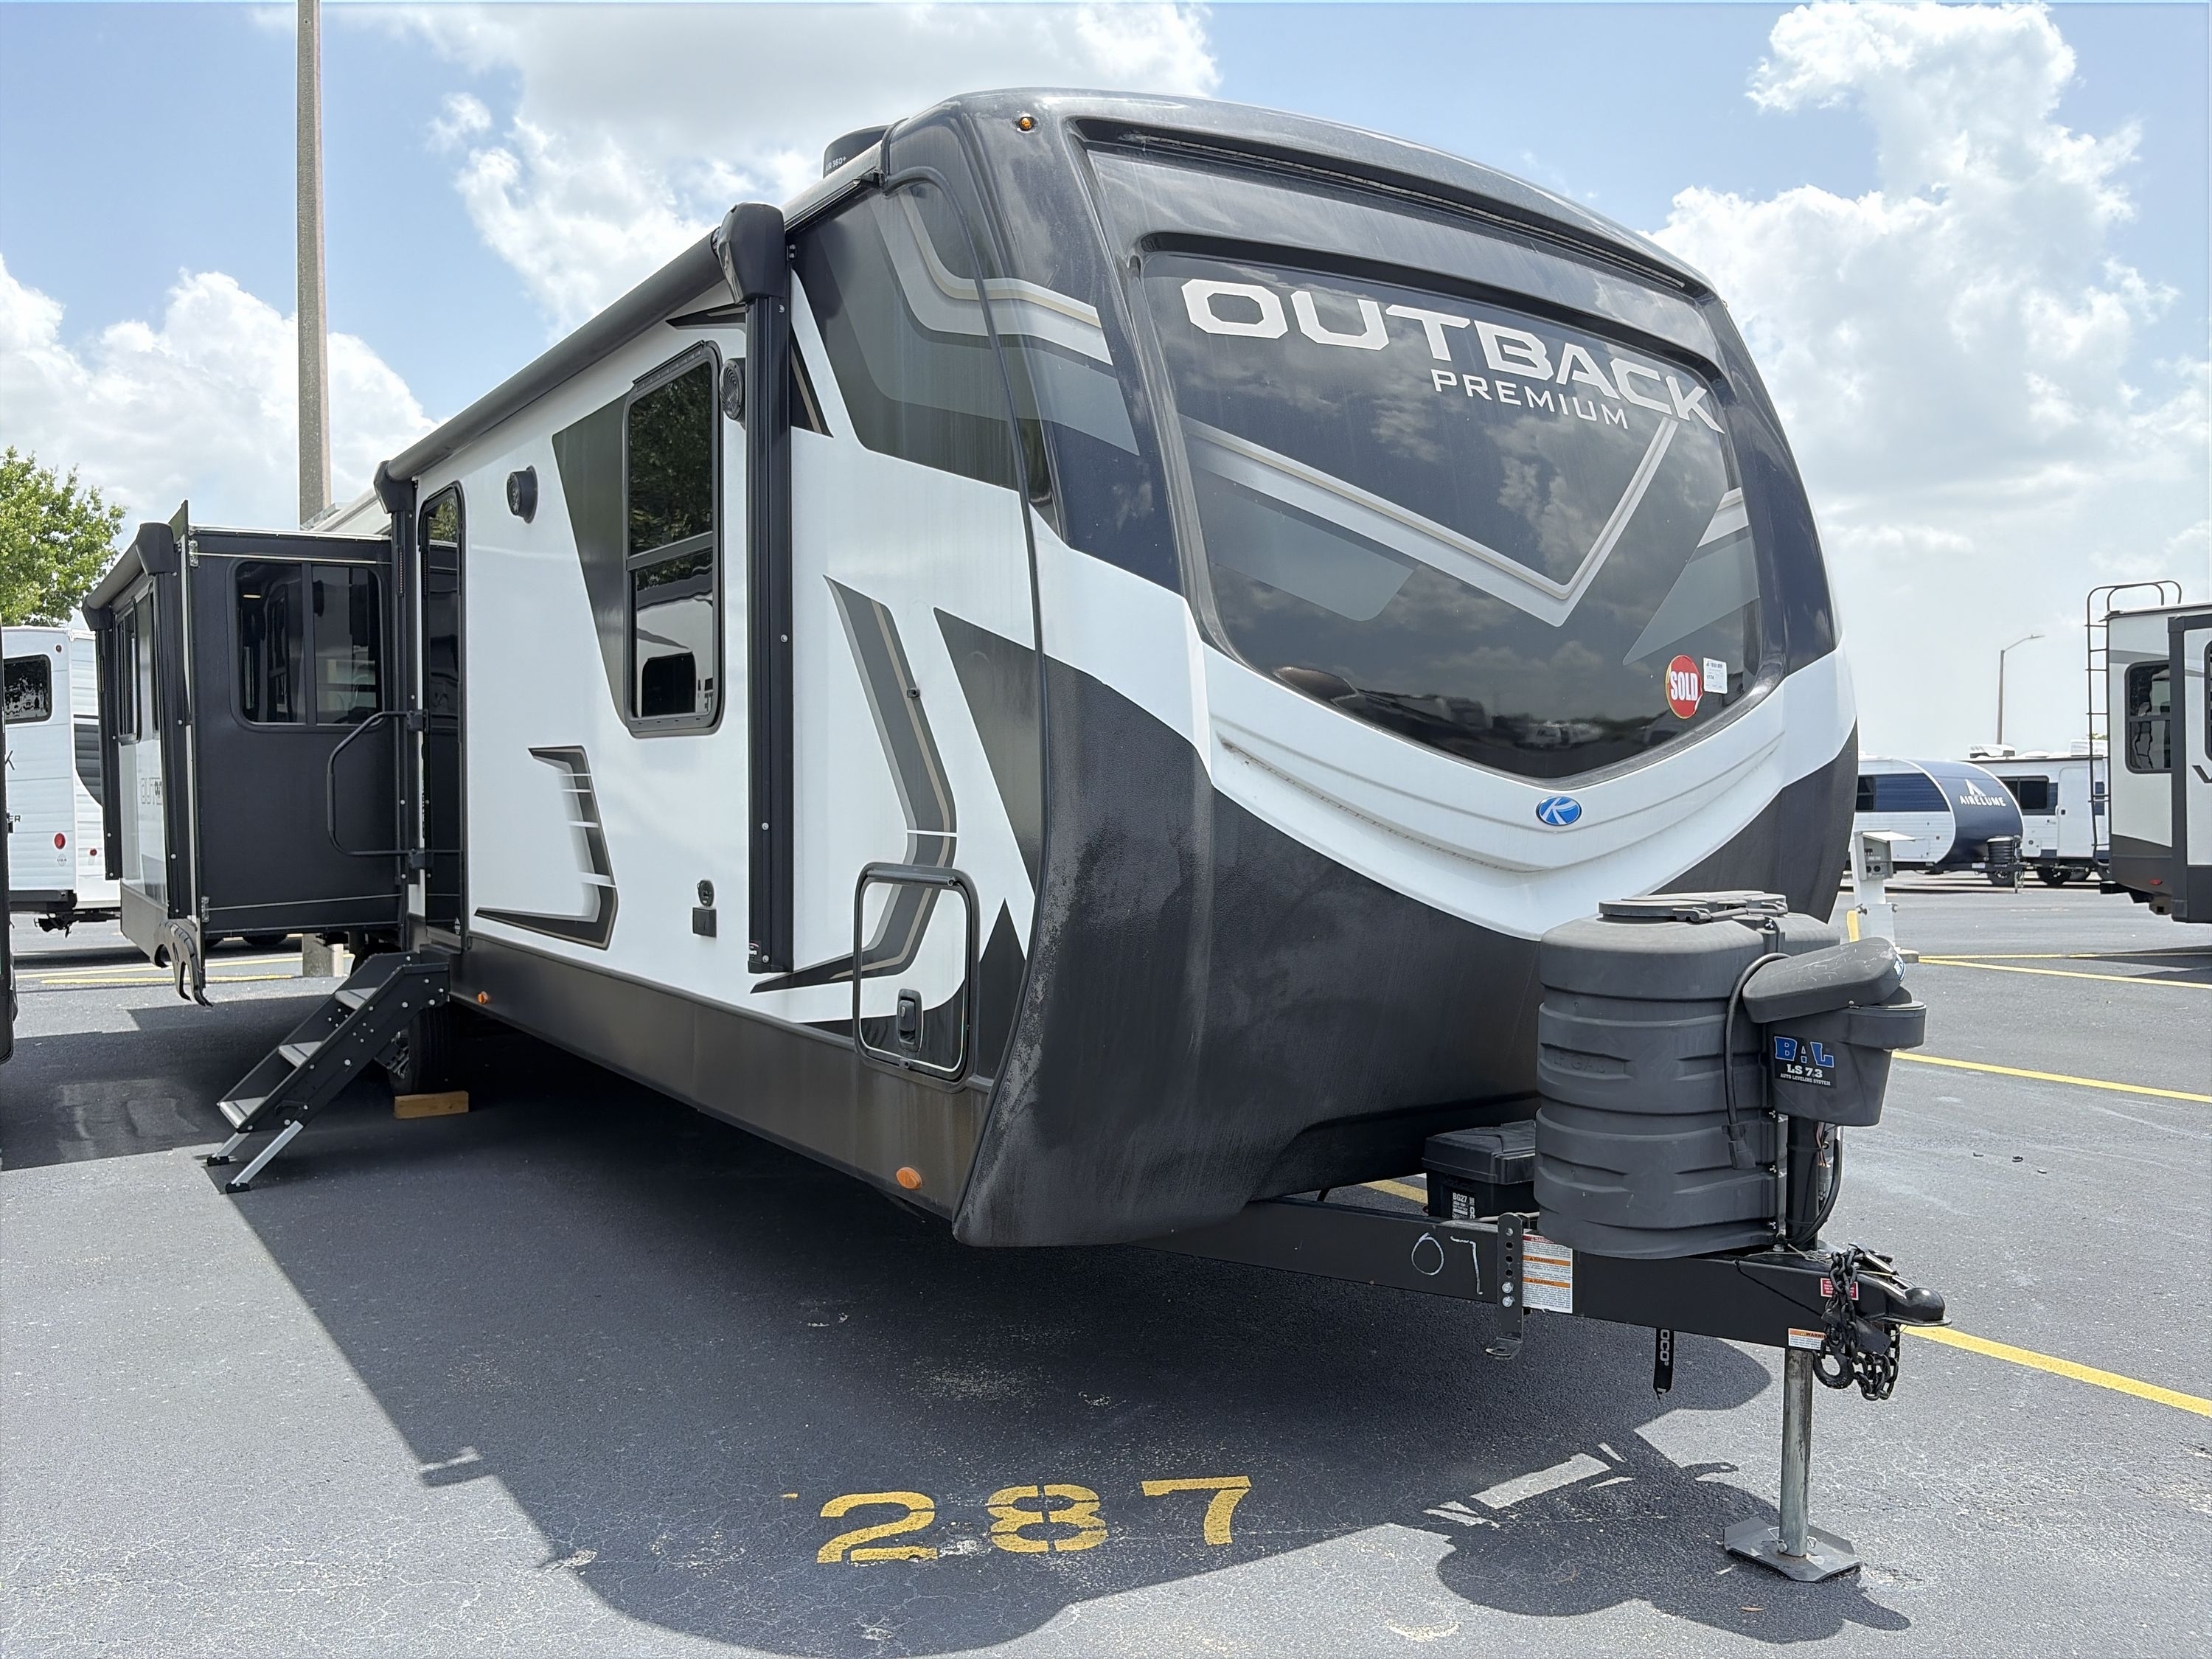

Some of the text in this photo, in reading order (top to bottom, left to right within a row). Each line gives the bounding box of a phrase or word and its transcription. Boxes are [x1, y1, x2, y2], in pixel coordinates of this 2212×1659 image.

[1181, 278, 1725, 434] OUTBACK
[1431, 369, 1629, 430] PREMIUM
[1670, 671, 1698, 701] SOLD
[1959, 795, 2006, 807] AIRELUME
[1774, 1036, 1834, 1068] BAL
[1787, 1064, 1803, 1075] LS
[1792, 1075, 1813, 1083] LEVELING
[1453, 1192, 1468, 1203] BG27
[1534, 1256, 1555, 1264] WARNING
[817, 1475, 1252, 1564] 287
